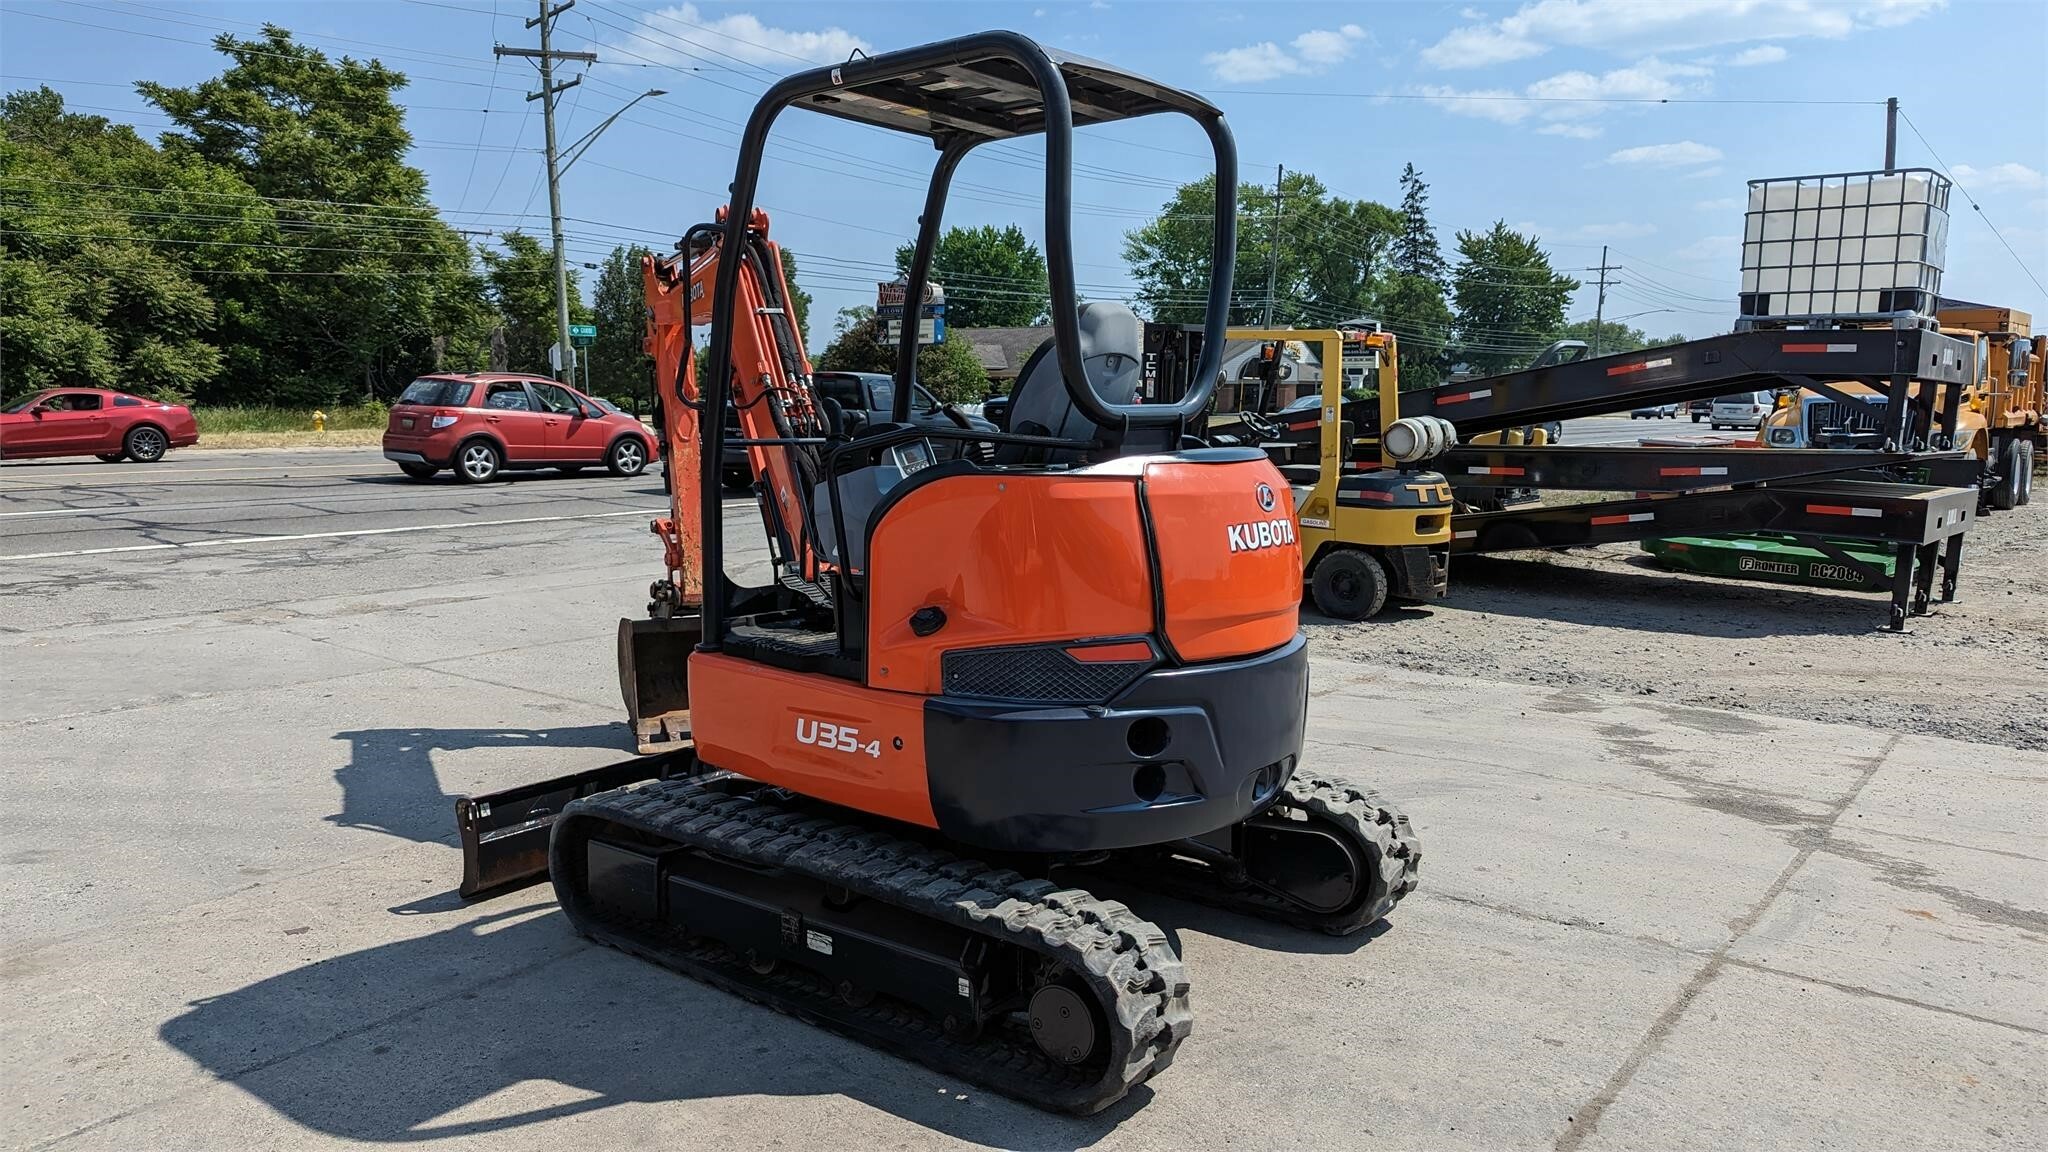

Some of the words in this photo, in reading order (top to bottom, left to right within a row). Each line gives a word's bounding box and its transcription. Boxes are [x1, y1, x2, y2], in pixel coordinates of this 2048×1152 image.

[1145, 352, 1157, 378] TCM
[1227, 519, 1295, 553] KUBOTA
[1740, 556, 1799, 575] FRONTIER
[796, 718, 881, 758] U35-4
